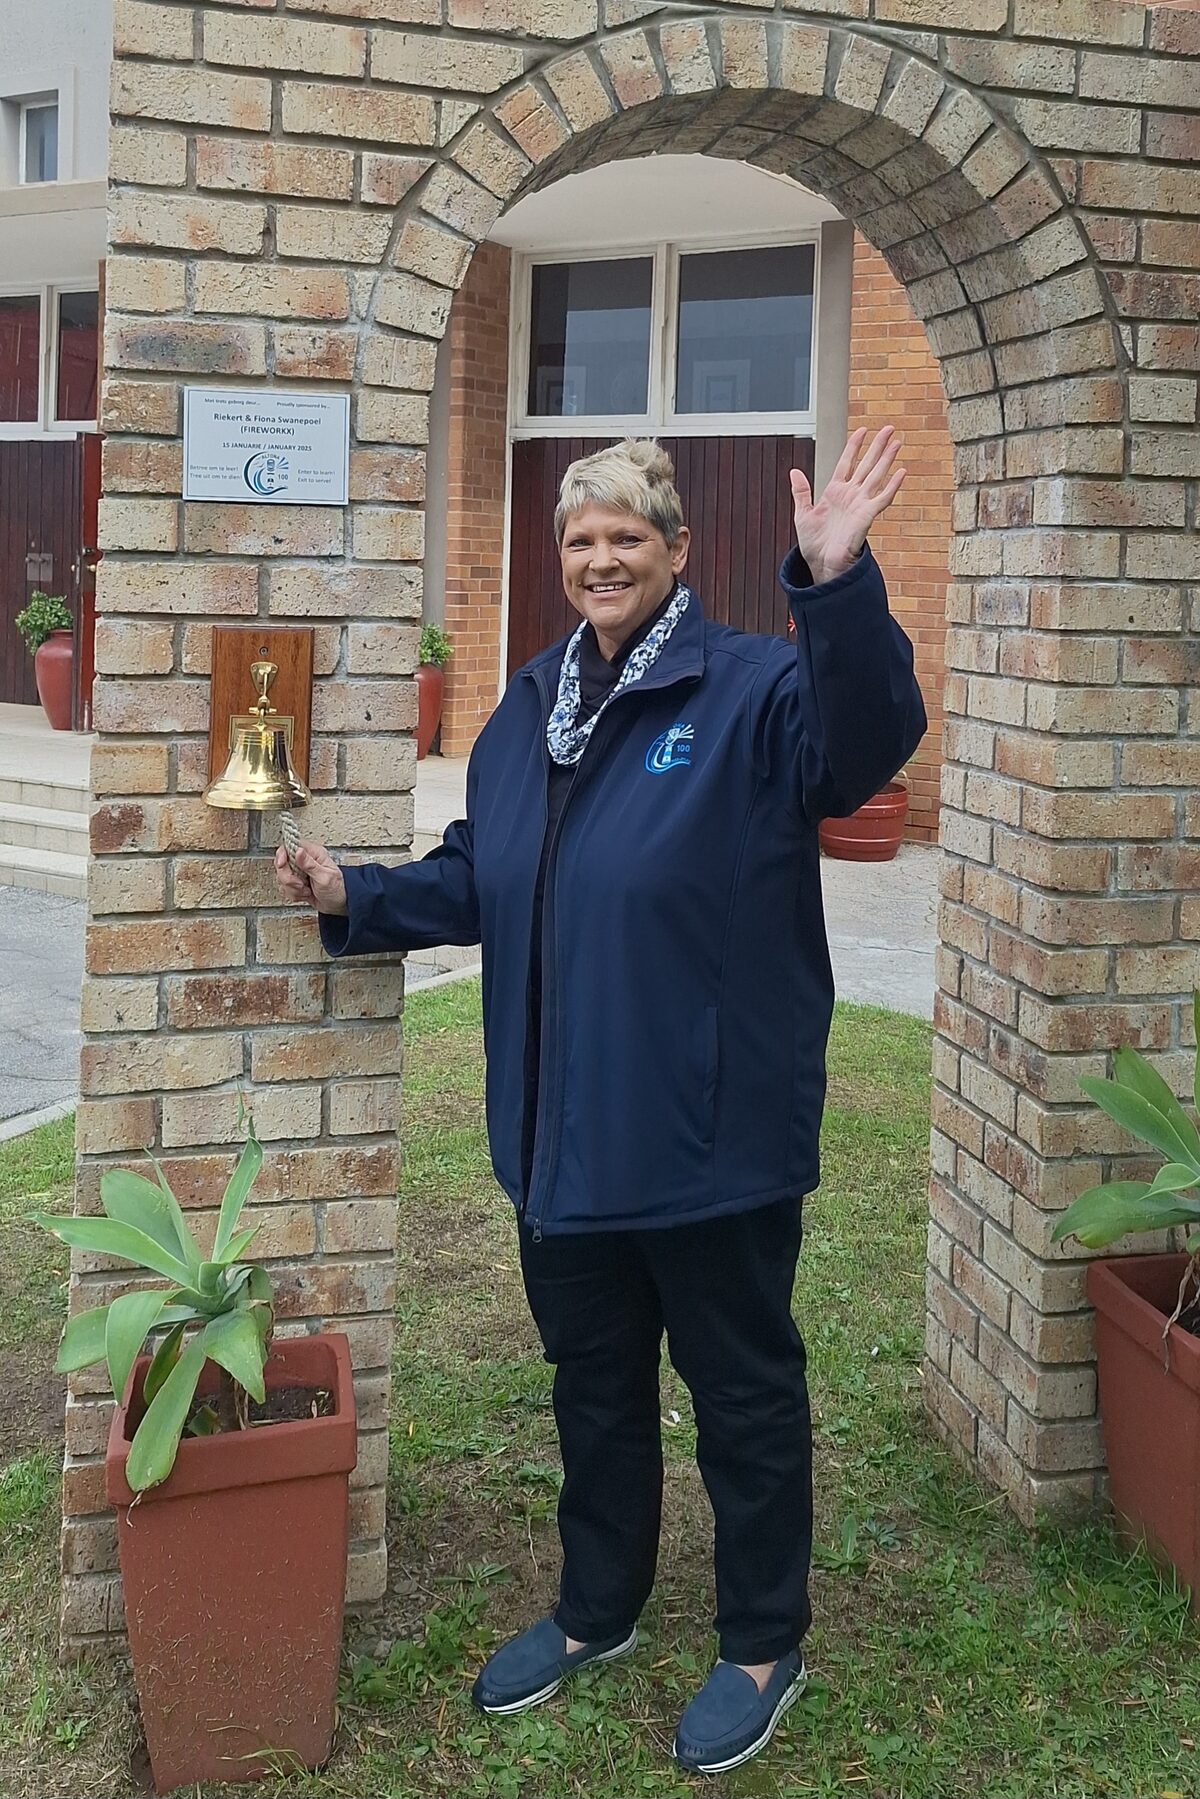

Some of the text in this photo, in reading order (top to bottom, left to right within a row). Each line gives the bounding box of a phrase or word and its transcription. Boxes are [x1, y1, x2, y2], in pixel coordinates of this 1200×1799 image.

[214, 413, 321, 425] Riekert & Fiona Swanepoel
[241, 426, 295, 436] (FIREWORKX)
[677, 744, 691, 752] 100
